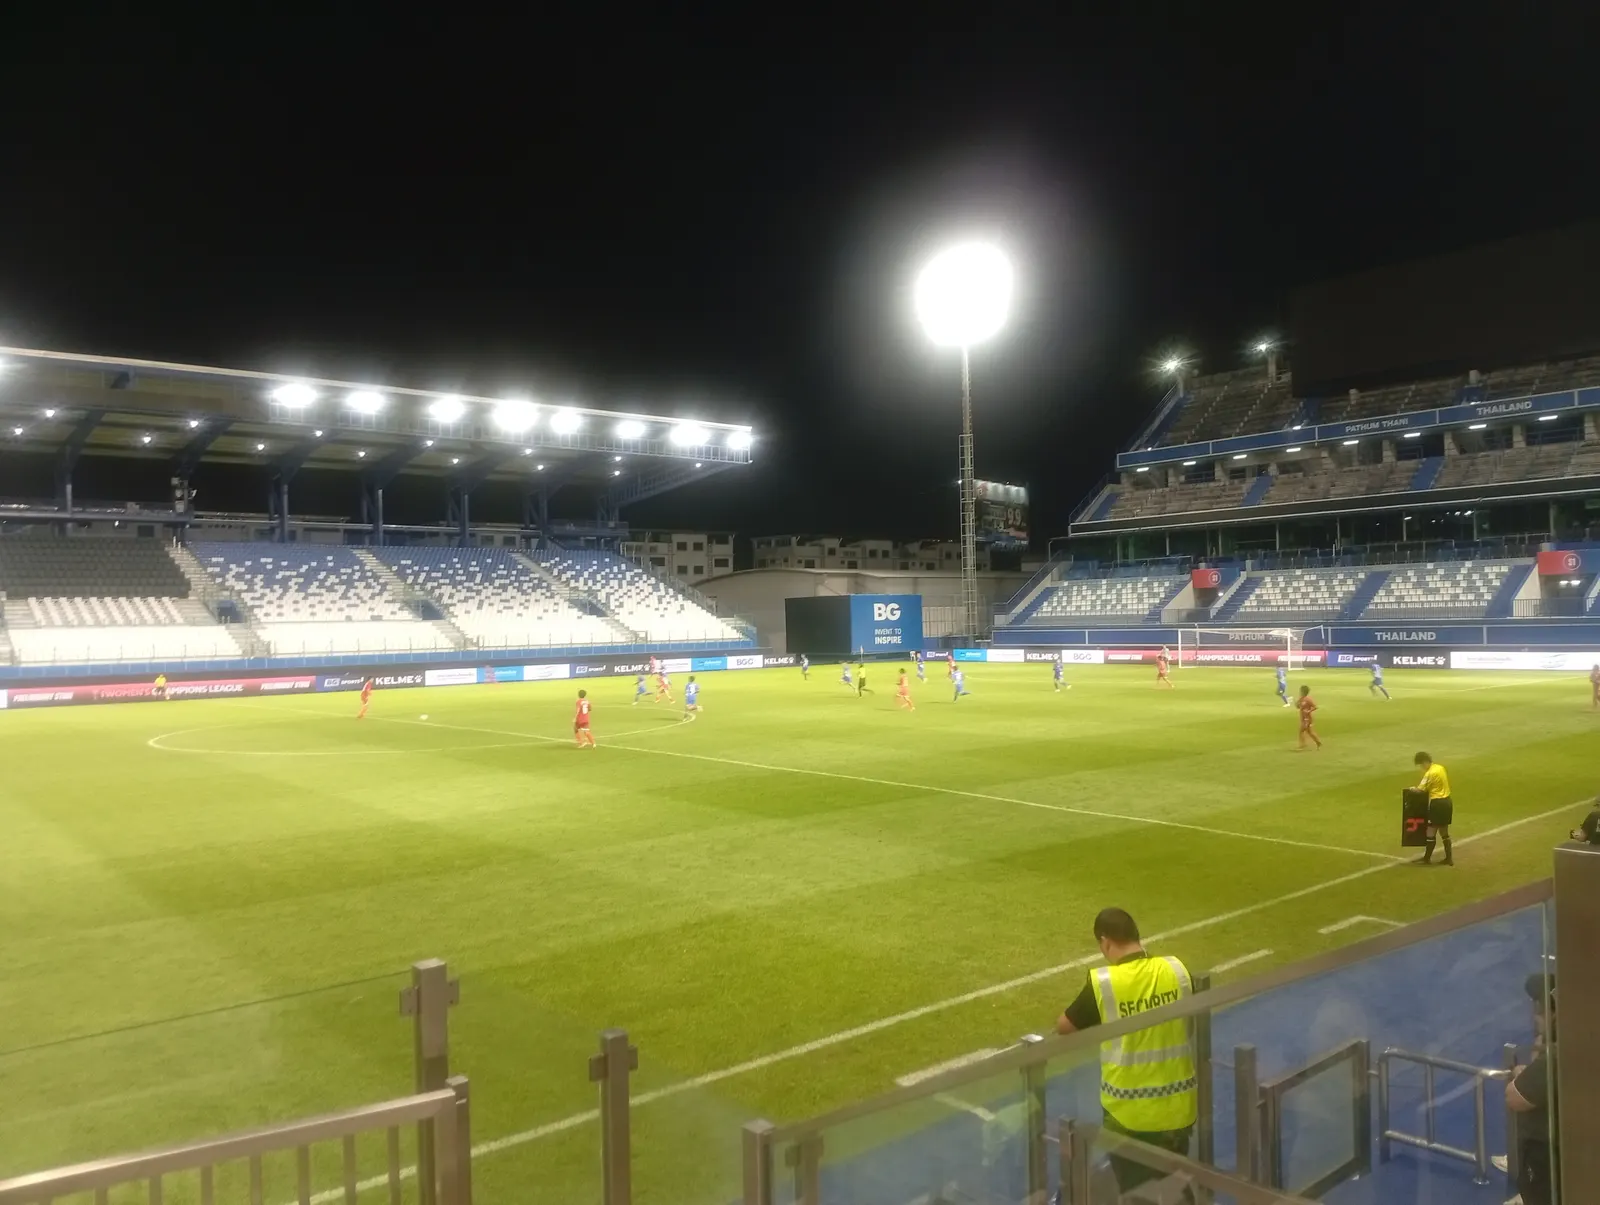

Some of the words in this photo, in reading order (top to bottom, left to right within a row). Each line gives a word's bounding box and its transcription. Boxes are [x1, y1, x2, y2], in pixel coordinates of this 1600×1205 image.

[1476, 401, 1532, 415] THAILAND
[1345, 421, 1380, 432] PATHUM
[1381, 418, 1409, 427] THANI
[873, 603, 901, 621] BG
[875, 636, 902, 645] INSPIRE
[1228, 633, 1265, 641] PATHUM
[1375, 631, 1436, 641] THAILAND
[737, 658, 754, 666] BGC
[1393, 656, 1435, 665] KELME
[376, 676, 414, 685] KELME
[209, 683, 244, 692] LEAGUE
